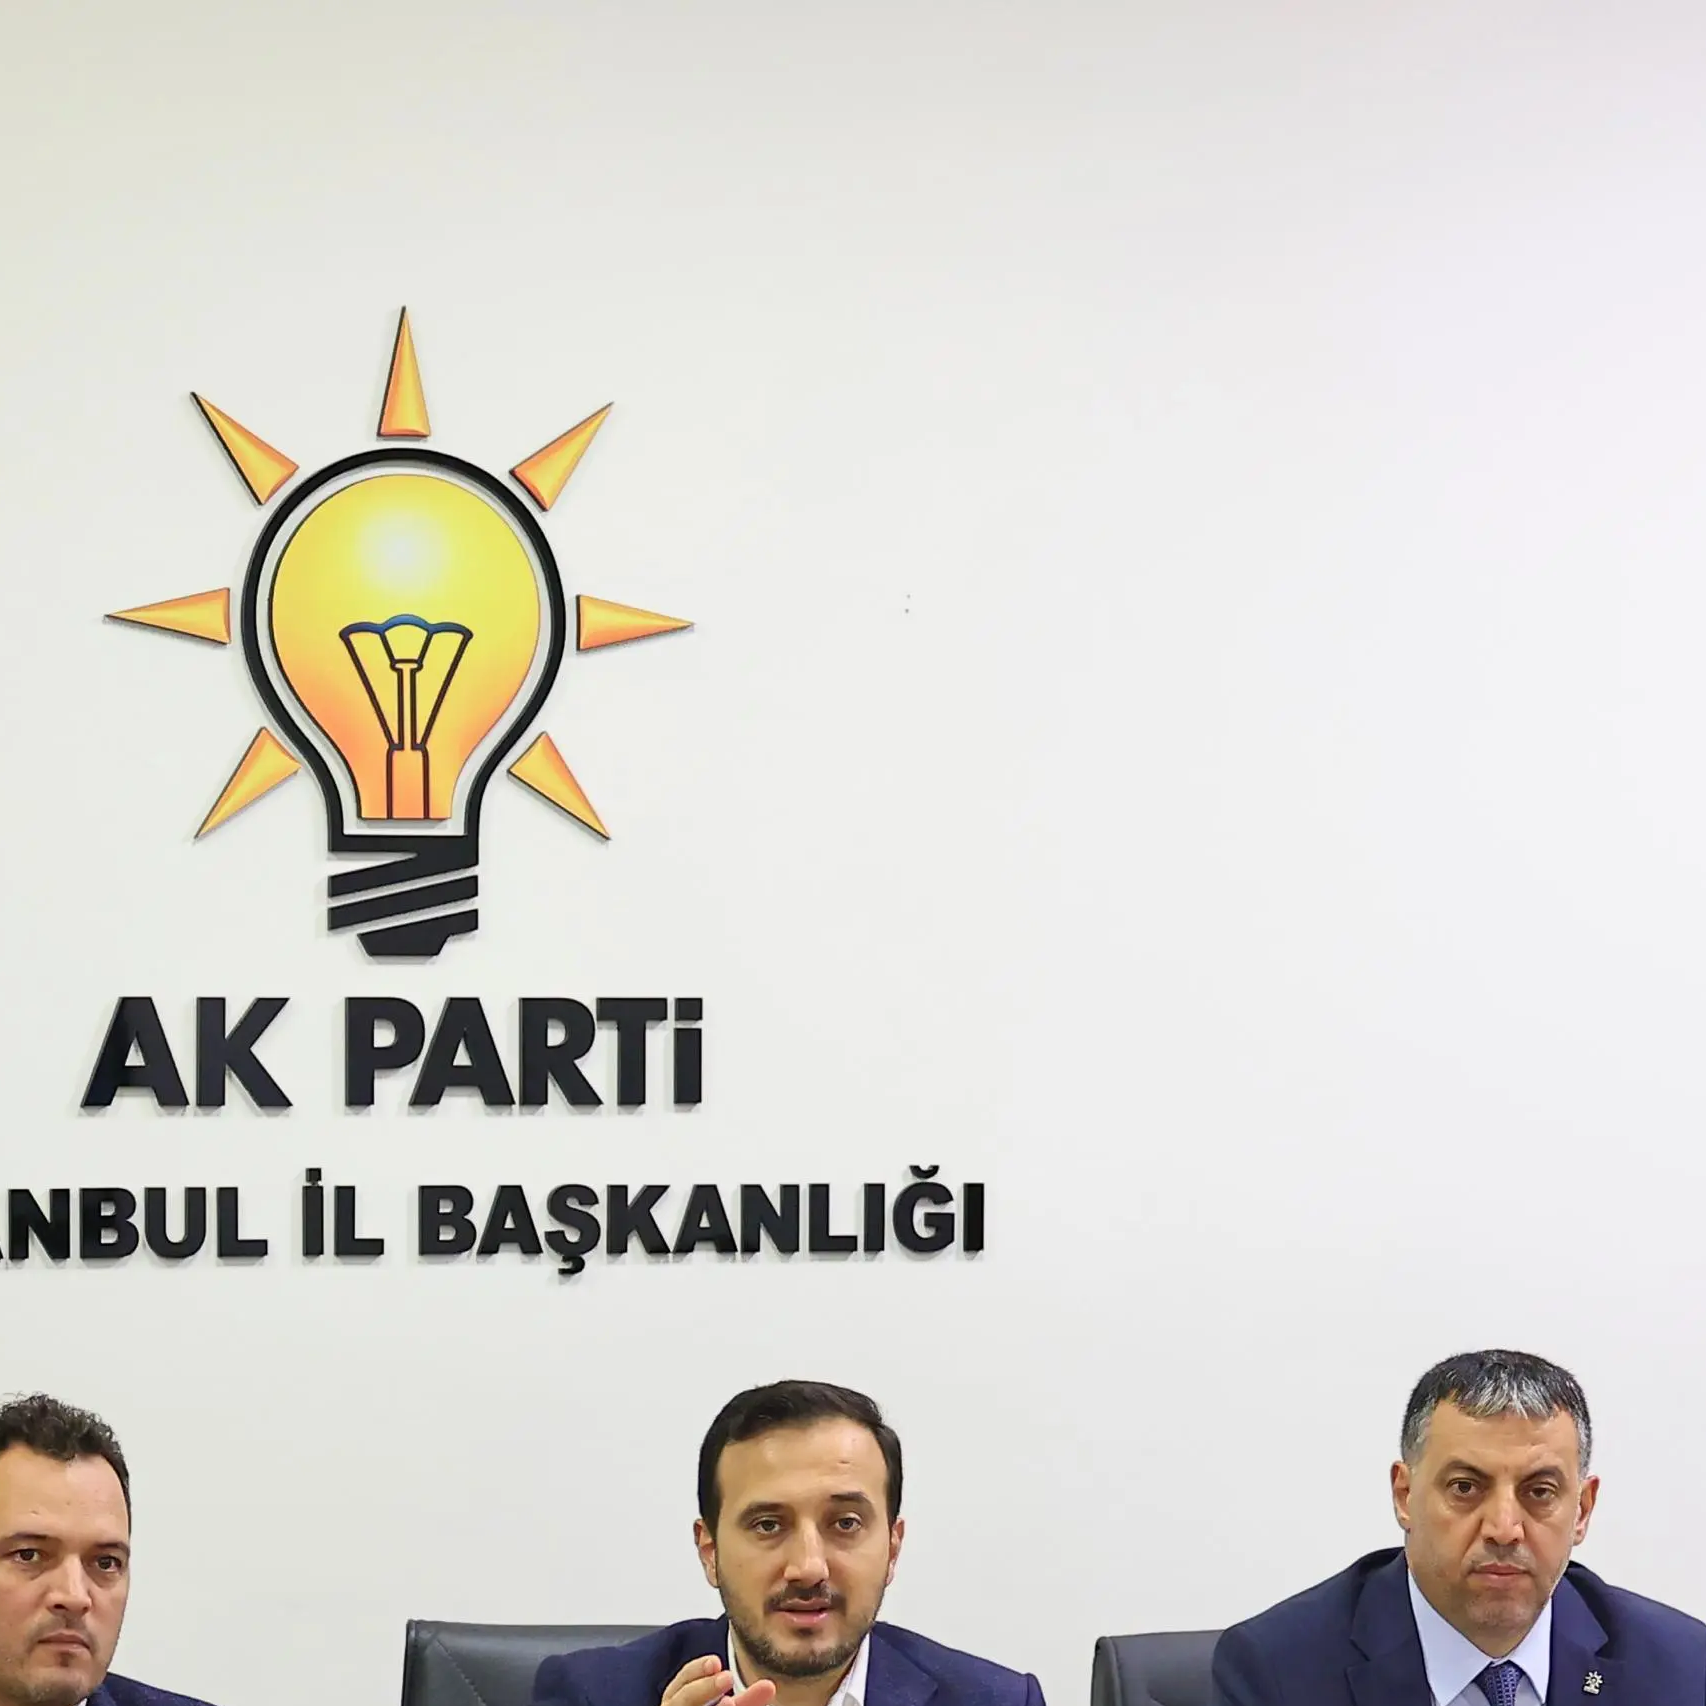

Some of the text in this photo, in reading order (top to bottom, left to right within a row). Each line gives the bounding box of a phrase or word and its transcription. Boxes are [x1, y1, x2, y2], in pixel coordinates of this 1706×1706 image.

[81, 996, 293, 1109] AK
[302, 1167, 385, 1258] İL
[418, 1165, 985, 1276] BAŞKANLIĞI
